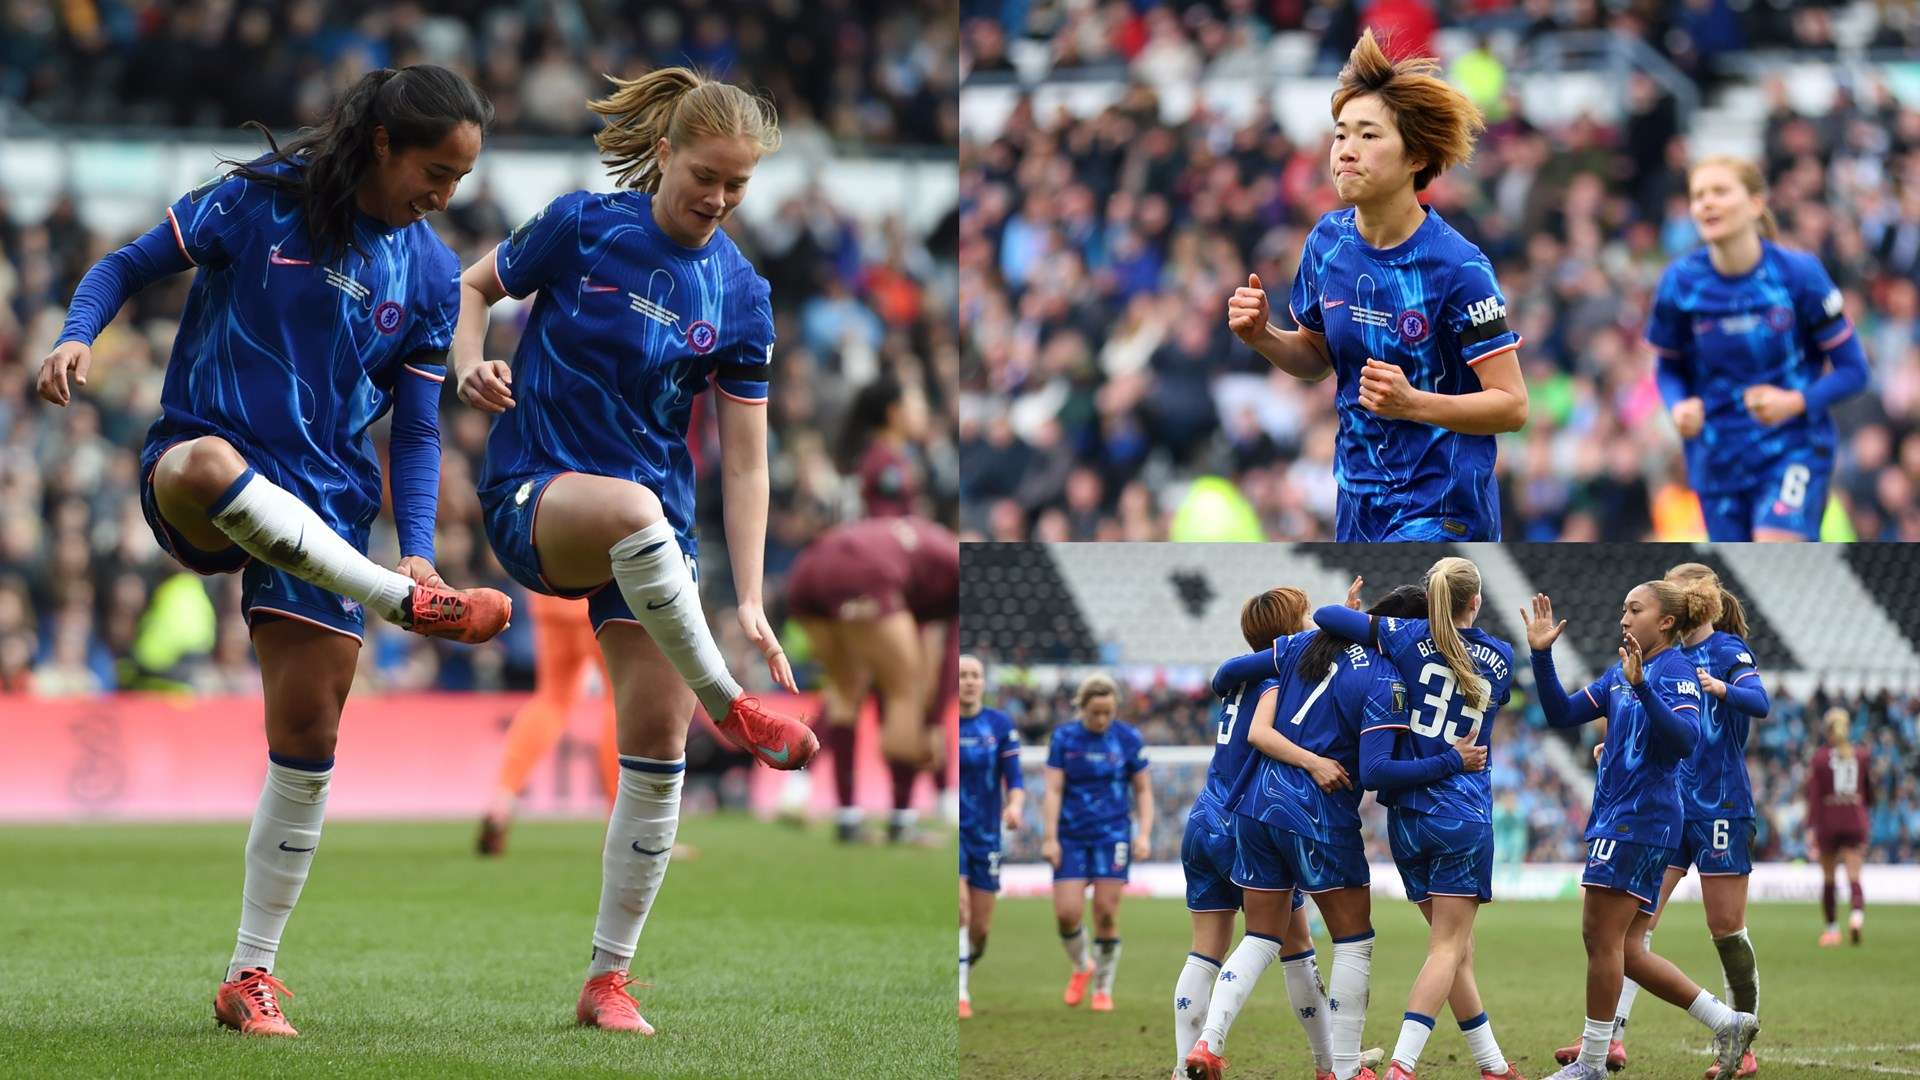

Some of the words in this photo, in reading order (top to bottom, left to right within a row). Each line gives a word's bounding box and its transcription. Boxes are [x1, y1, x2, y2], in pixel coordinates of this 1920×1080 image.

[1467, 296, 1497, 317] LIVE
[1779, 463, 1811, 508] 6
[1409, 662, 1492, 747] 33
[1591, 839, 1616, 861] 10
[1712, 819, 1729, 850] 6
